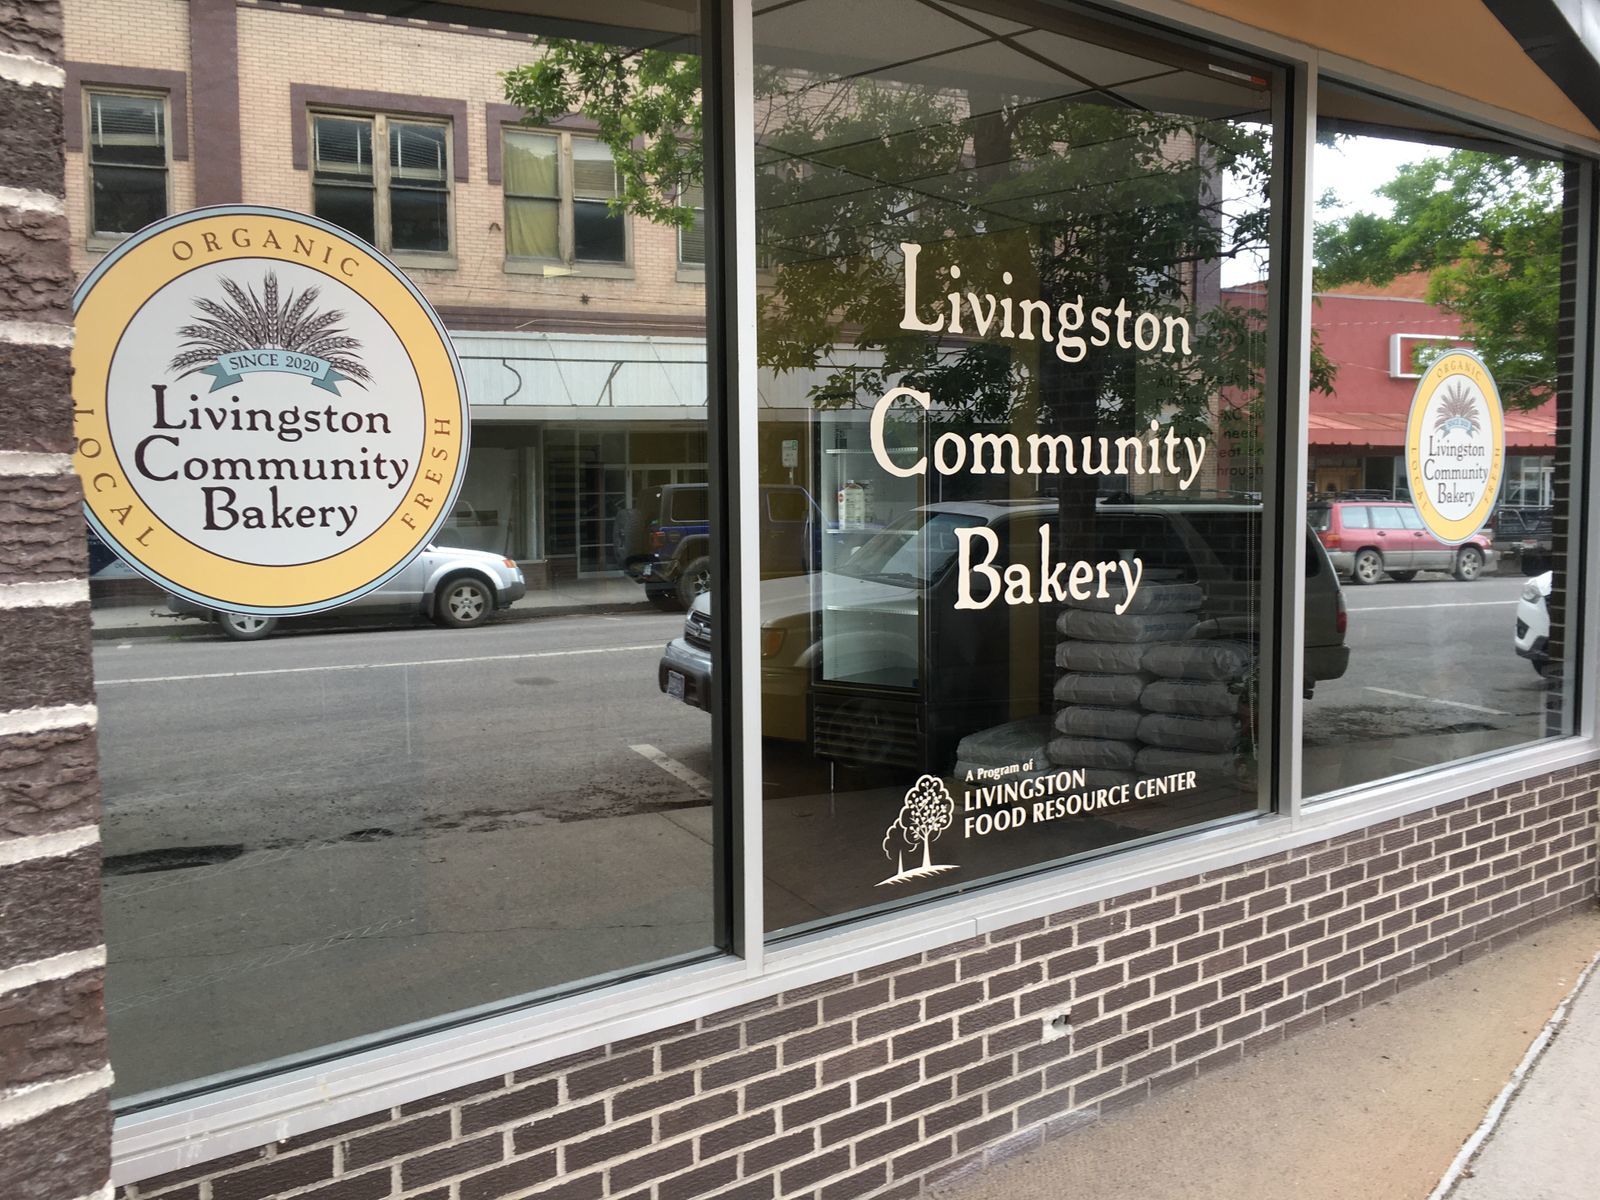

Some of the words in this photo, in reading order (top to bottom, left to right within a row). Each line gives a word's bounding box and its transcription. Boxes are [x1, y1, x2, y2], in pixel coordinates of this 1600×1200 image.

[172, 228, 360, 277] ORGANIC
[899, 242, 1192, 363] Livingston
[229, 353, 280, 372] SINCE
[285, 354, 320, 374] 2020
[1436, 360, 1482, 381] ORGANIC
[151, 384, 391, 442] Livingston
[134, 435, 409, 489] Community
[869, 386, 1206, 491] Community
[1429, 435, 1485, 461] Livingston
[401, 418, 451, 530] FRESH
[1424, 459, 1489, 483] Community
[1437, 483, 1475, 507] Bakery
[201, 485, 358, 536] Bakery
[953, 523, 1143, 615] Bakery
[964, 768, 1086, 811] LIVINGSTON
[965, 770, 974, 782] A
[977, 764, 1020, 781] Program
[1022, 759, 1034, 772] of
[964, 806, 1026, 839] FOOD
[1032, 783, 1130, 823] RESOURCE
[1134, 770, 1197, 800] CENTER
